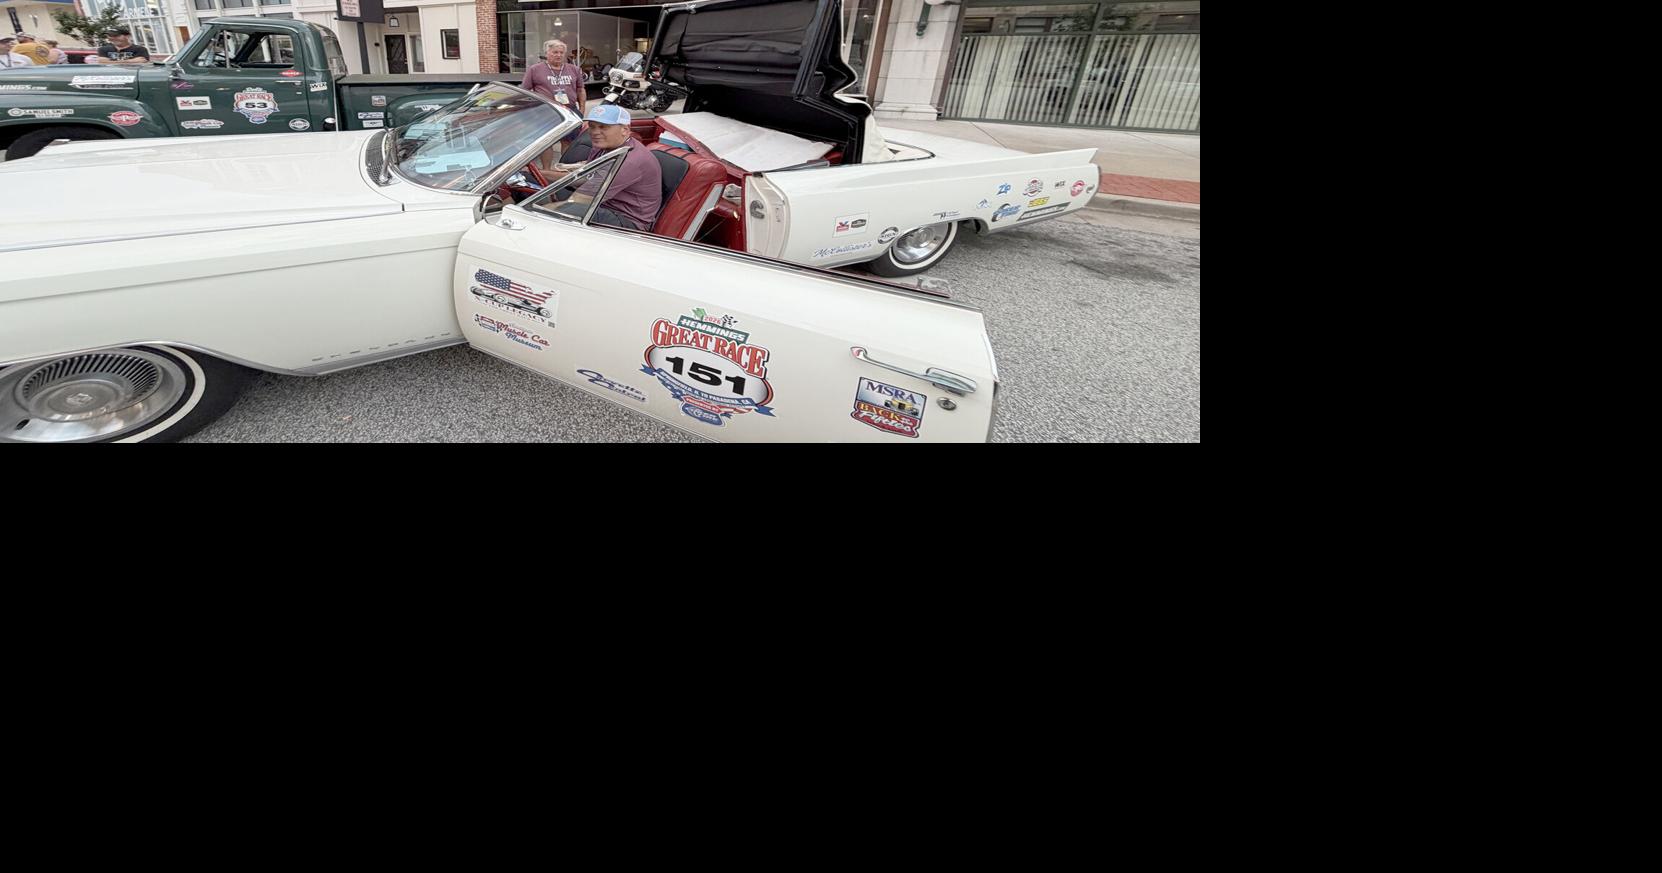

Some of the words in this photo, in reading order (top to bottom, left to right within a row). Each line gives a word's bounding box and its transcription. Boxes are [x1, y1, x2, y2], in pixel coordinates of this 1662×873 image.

[496, 320, 529, 339] Muscle
[531, 334, 551, 347] Car
[505, 332, 543, 350] Museum
[681, 318, 746, 341] HEMMINGS
[652, 319, 713, 350] GREAT
[712, 337, 767, 377] RACE
[665, 356, 746, 396] 151
[865, 380, 917, 405] MSRA
[860, 402, 902, 422] BACK
